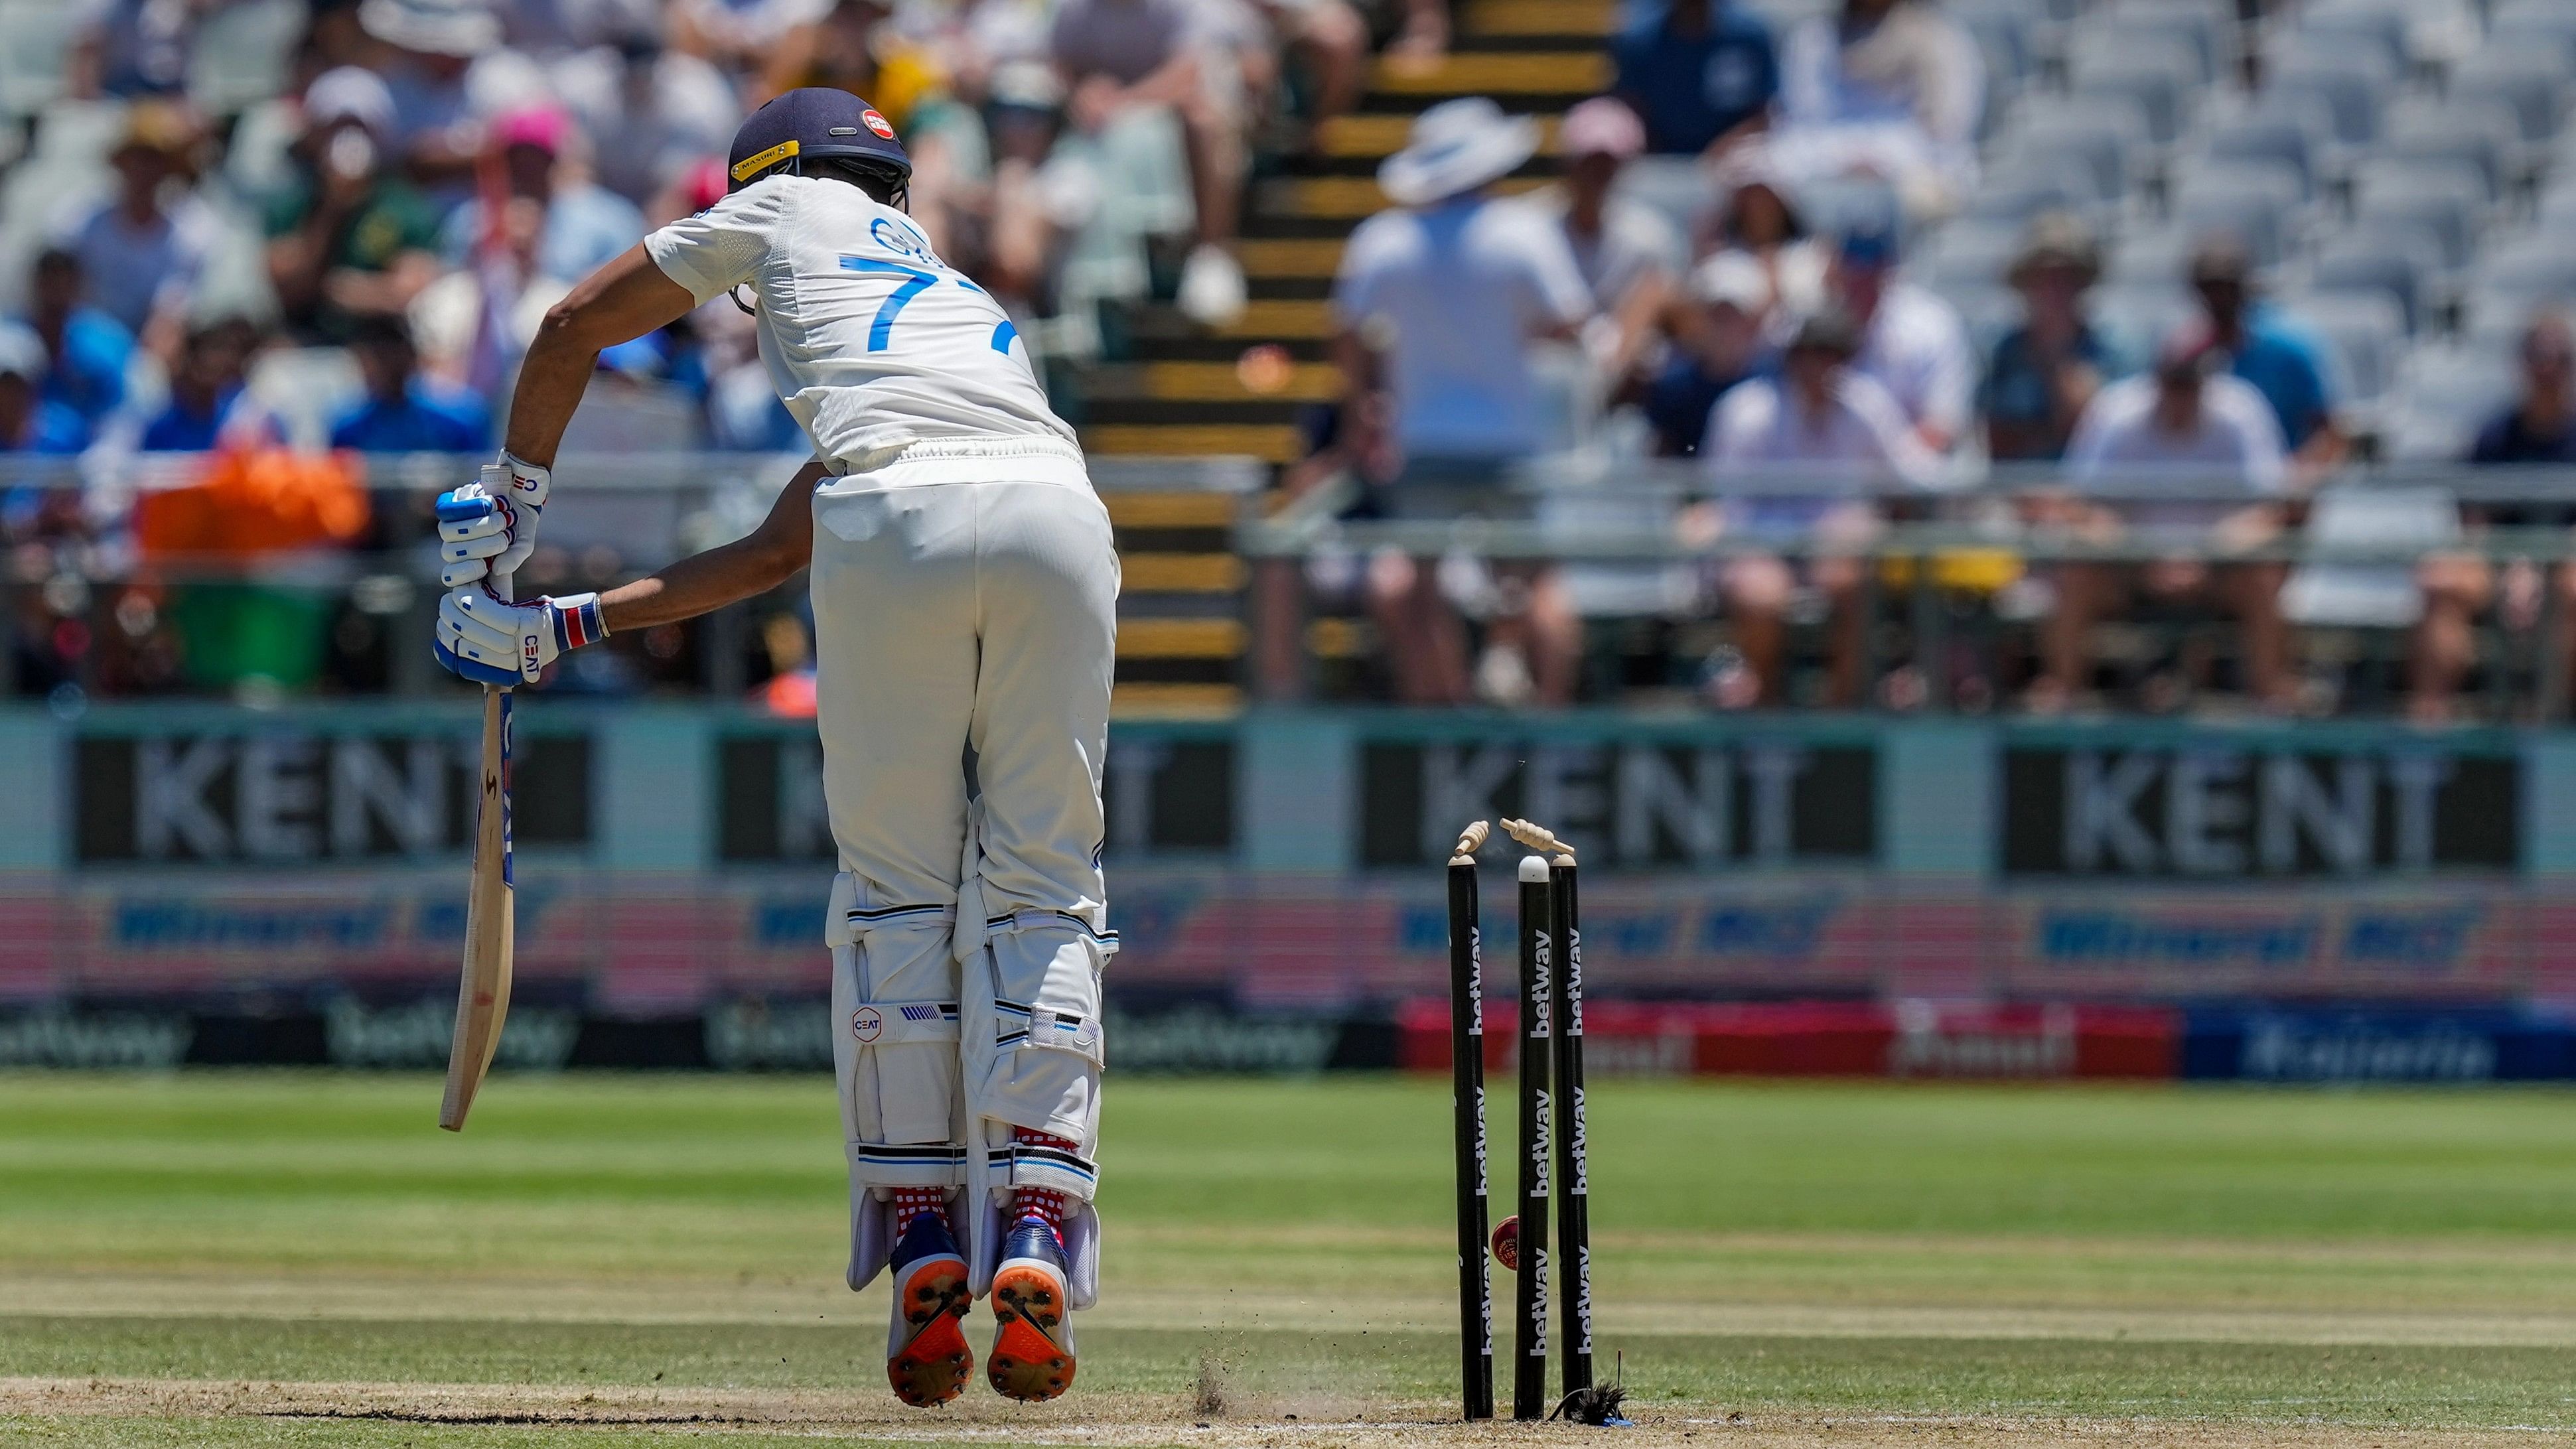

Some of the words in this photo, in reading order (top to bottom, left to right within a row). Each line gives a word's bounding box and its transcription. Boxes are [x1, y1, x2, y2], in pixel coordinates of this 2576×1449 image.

[742, 151, 776, 169] MASURI
[525, 635, 539, 673] CEAT
[1418, 743, 1815, 859] KENT
[2060, 750, 2459, 872] KENT
[855, 1020, 879, 1030] CEAT
[1468, 926, 1482, 1035] betway
[1530, 929, 1551, 1038] betway
[1567, 928, 1583, 1036] betway
[1530, 1089, 1549, 1198] betway
[1571, 1086, 1587, 1195] betway
[1530, 1247, 1547, 1355] betway
[1577, 1245, 1591, 1354] betway
